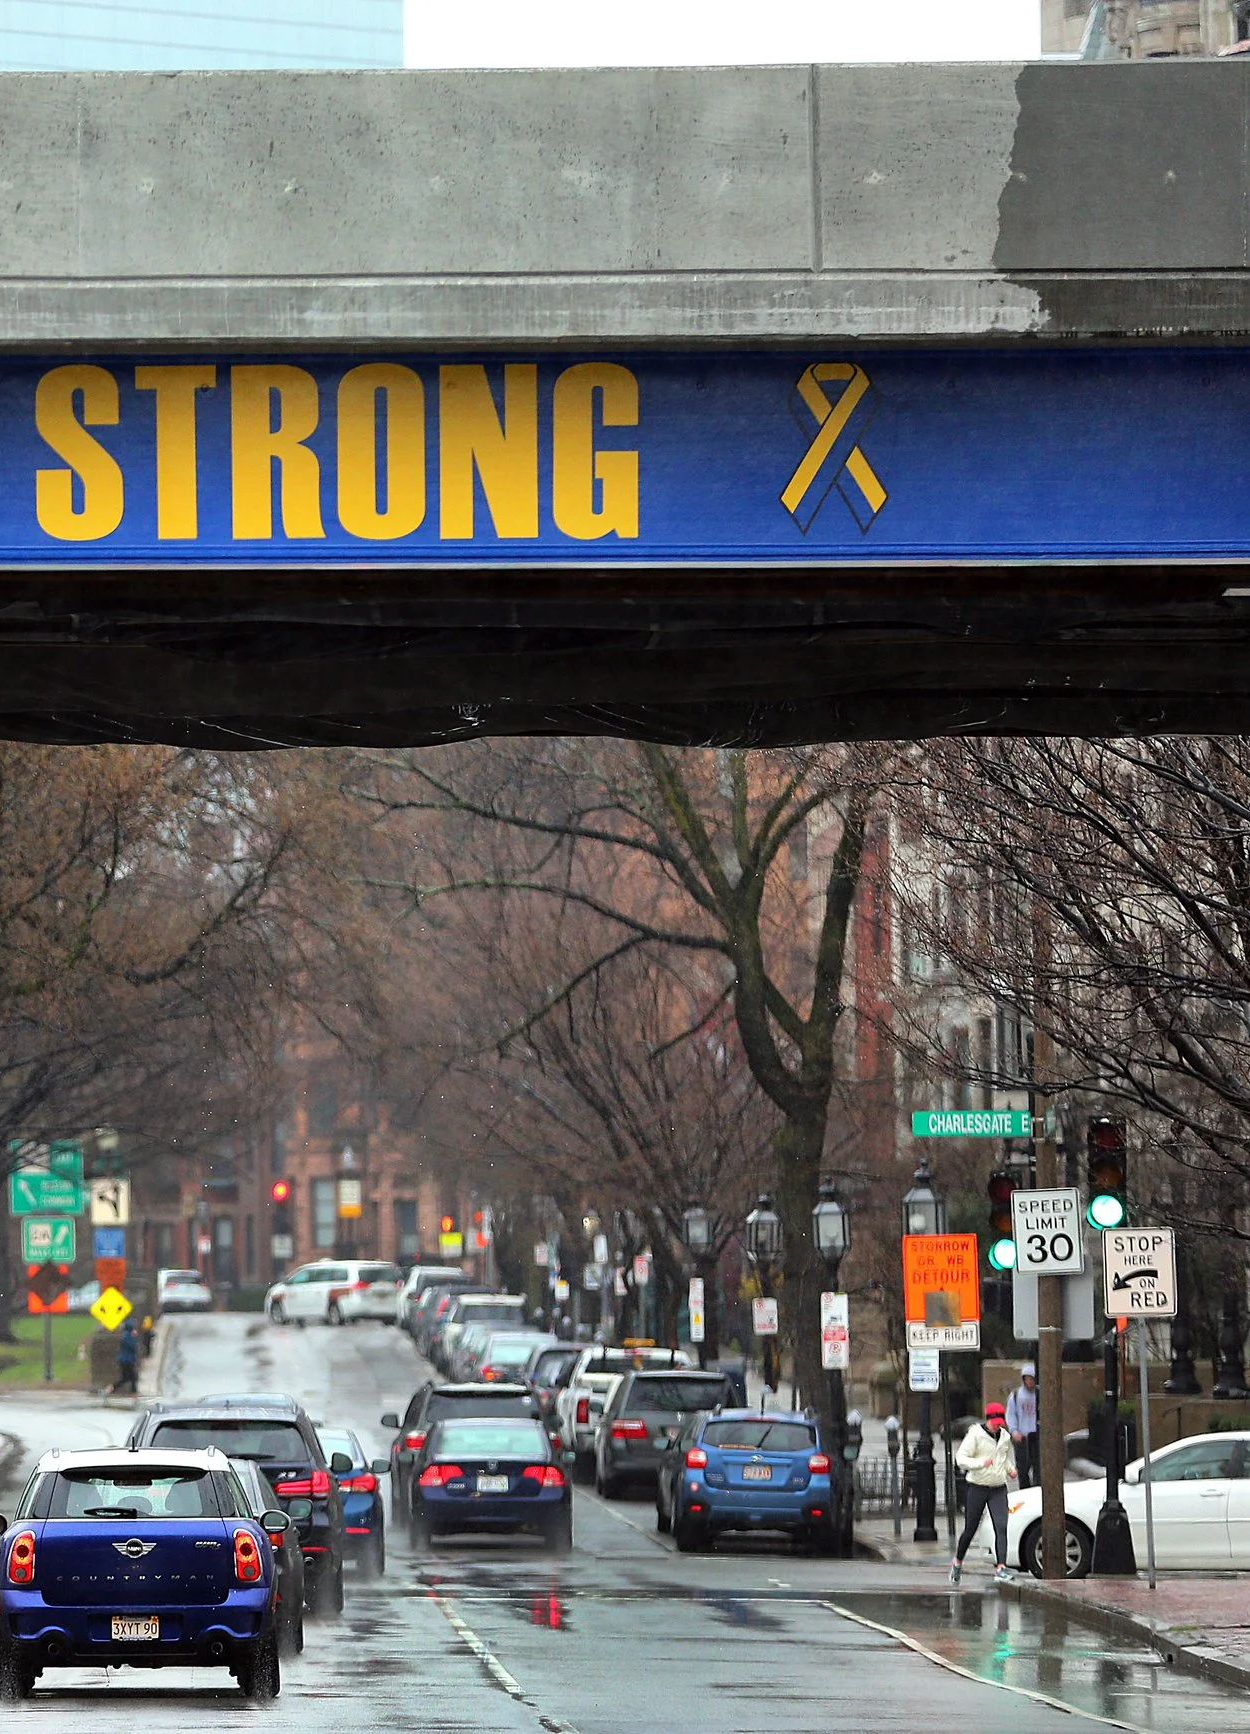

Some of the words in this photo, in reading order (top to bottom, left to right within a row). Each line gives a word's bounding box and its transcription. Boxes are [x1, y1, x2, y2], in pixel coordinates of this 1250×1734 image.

[35, 362, 639, 541] STRONG
[928, 1113, 1012, 1134] CHARLESGATE
[1021, 1114, 1029, 1132] E
[1018, 1199, 1073, 1214] SPEED
[1025, 1217, 1067, 1230] LIMIT
[911, 1240, 970, 1252] STORROW
[1026, 1232, 1074, 1263] 30
[1114, 1236, 1163, 1252] STOP
[946, 1254, 965, 1266] WB
[1124, 1254, 1154, 1266] HERE
[912, 1269, 971, 1285] DETOUR
[1139, 1278, 1156, 1289] ON
[1130, 1291, 1168, 1308] RED
[912, 1328, 939, 1342] KEEP
[944, 1327, 975, 1341] RIGHT
[56, 1574, 214, 1582] COUNTRYMAN
[113, 1622, 141, 1635] 3XYT
[143, 1622, 158, 1635] 90
